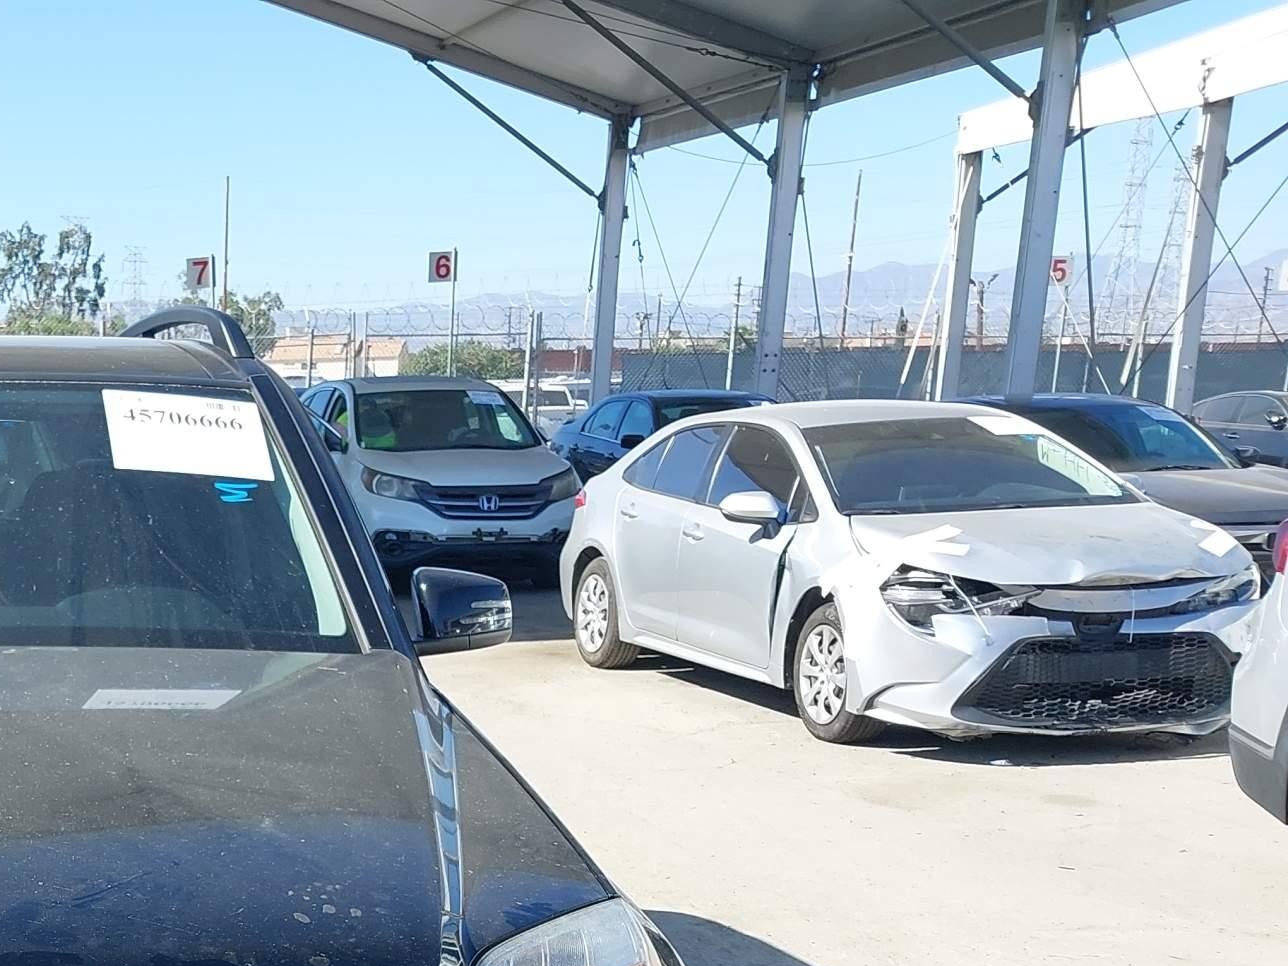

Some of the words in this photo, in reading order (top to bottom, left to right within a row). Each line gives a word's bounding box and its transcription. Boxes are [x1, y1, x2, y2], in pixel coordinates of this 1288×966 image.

[191, 260, 209, 286] 7
[435, 254, 451, 279] 6
[1052, 259, 1067, 282] 5
[122, 407, 243, 431] 45706666
